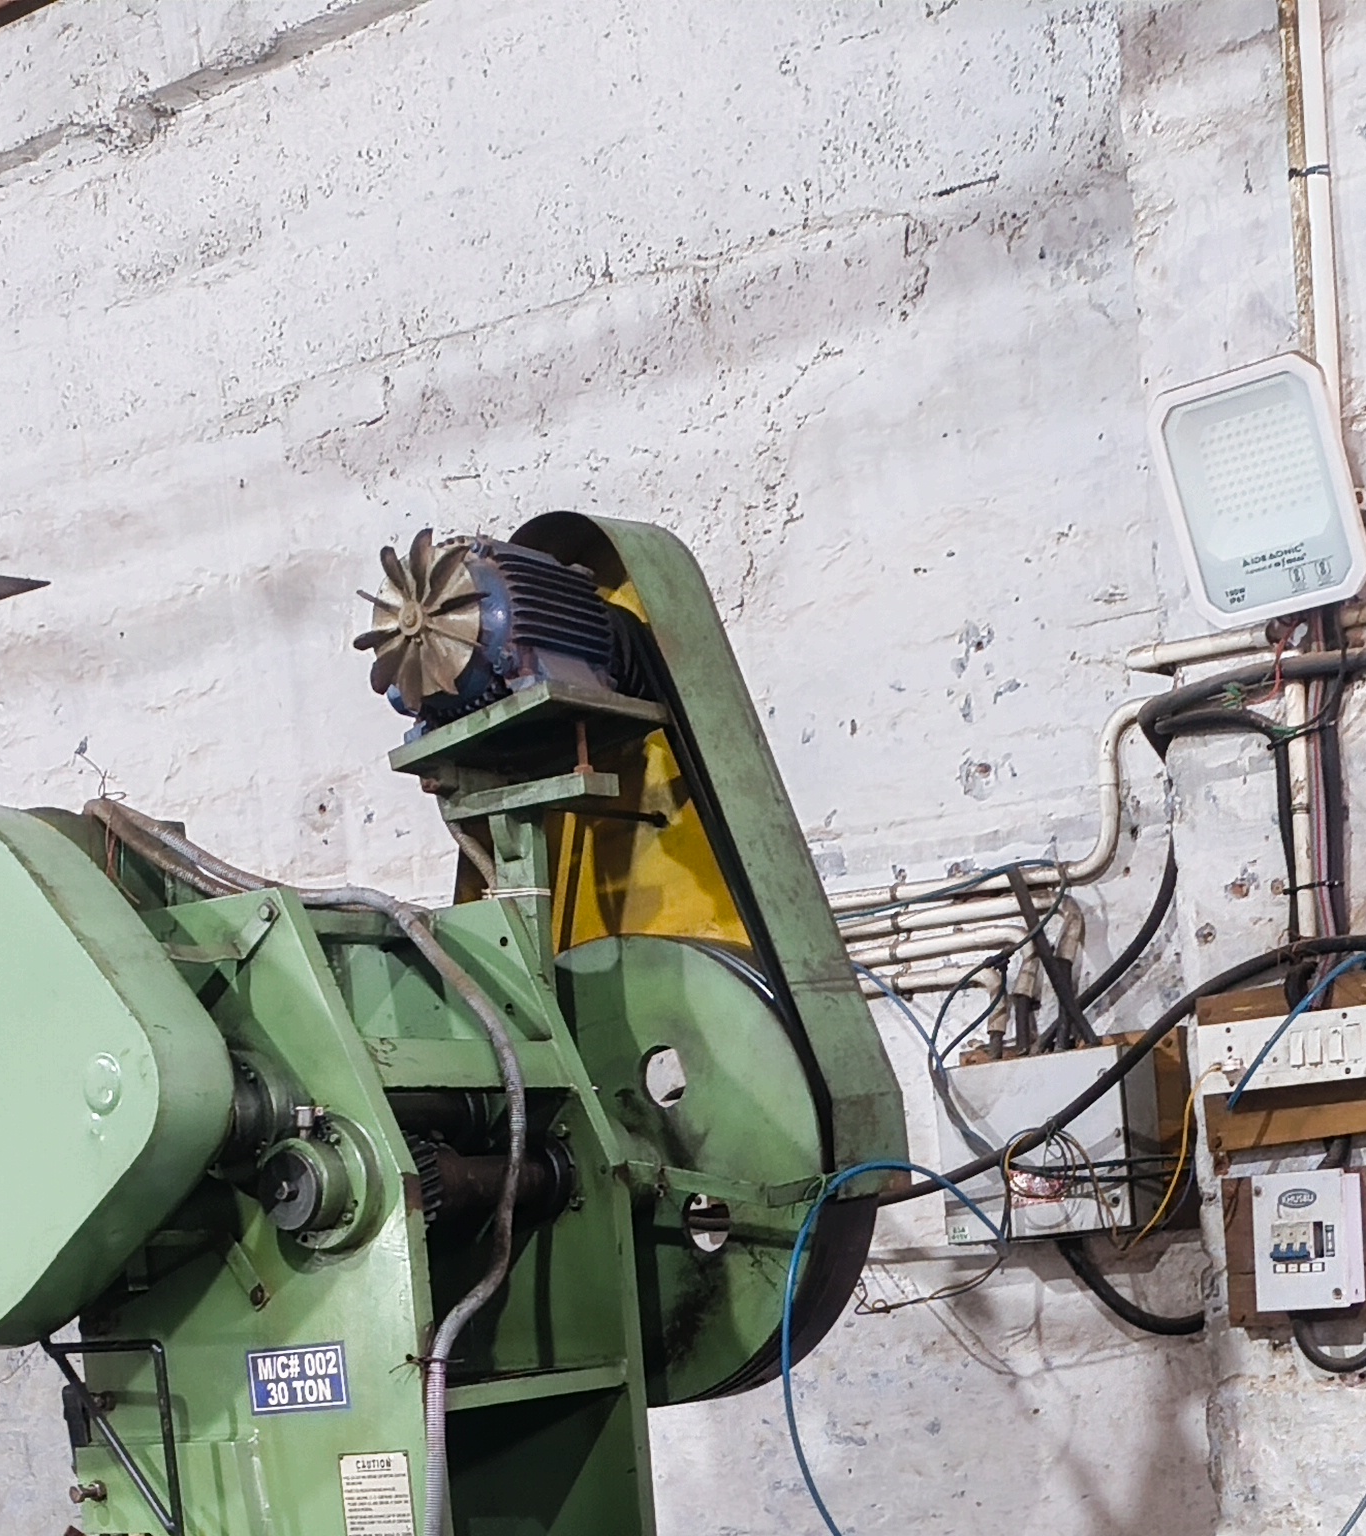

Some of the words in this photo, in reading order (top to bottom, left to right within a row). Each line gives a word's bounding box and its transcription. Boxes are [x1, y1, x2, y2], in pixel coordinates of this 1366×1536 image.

[257, 1354, 300, 1380] M/C#
[304, 1350, 338, 1376] 002
[266, 1381, 289, 1405] 30
[292, 1377, 333, 1403] TON
[355, 1458, 392, 1469] CAUTION
